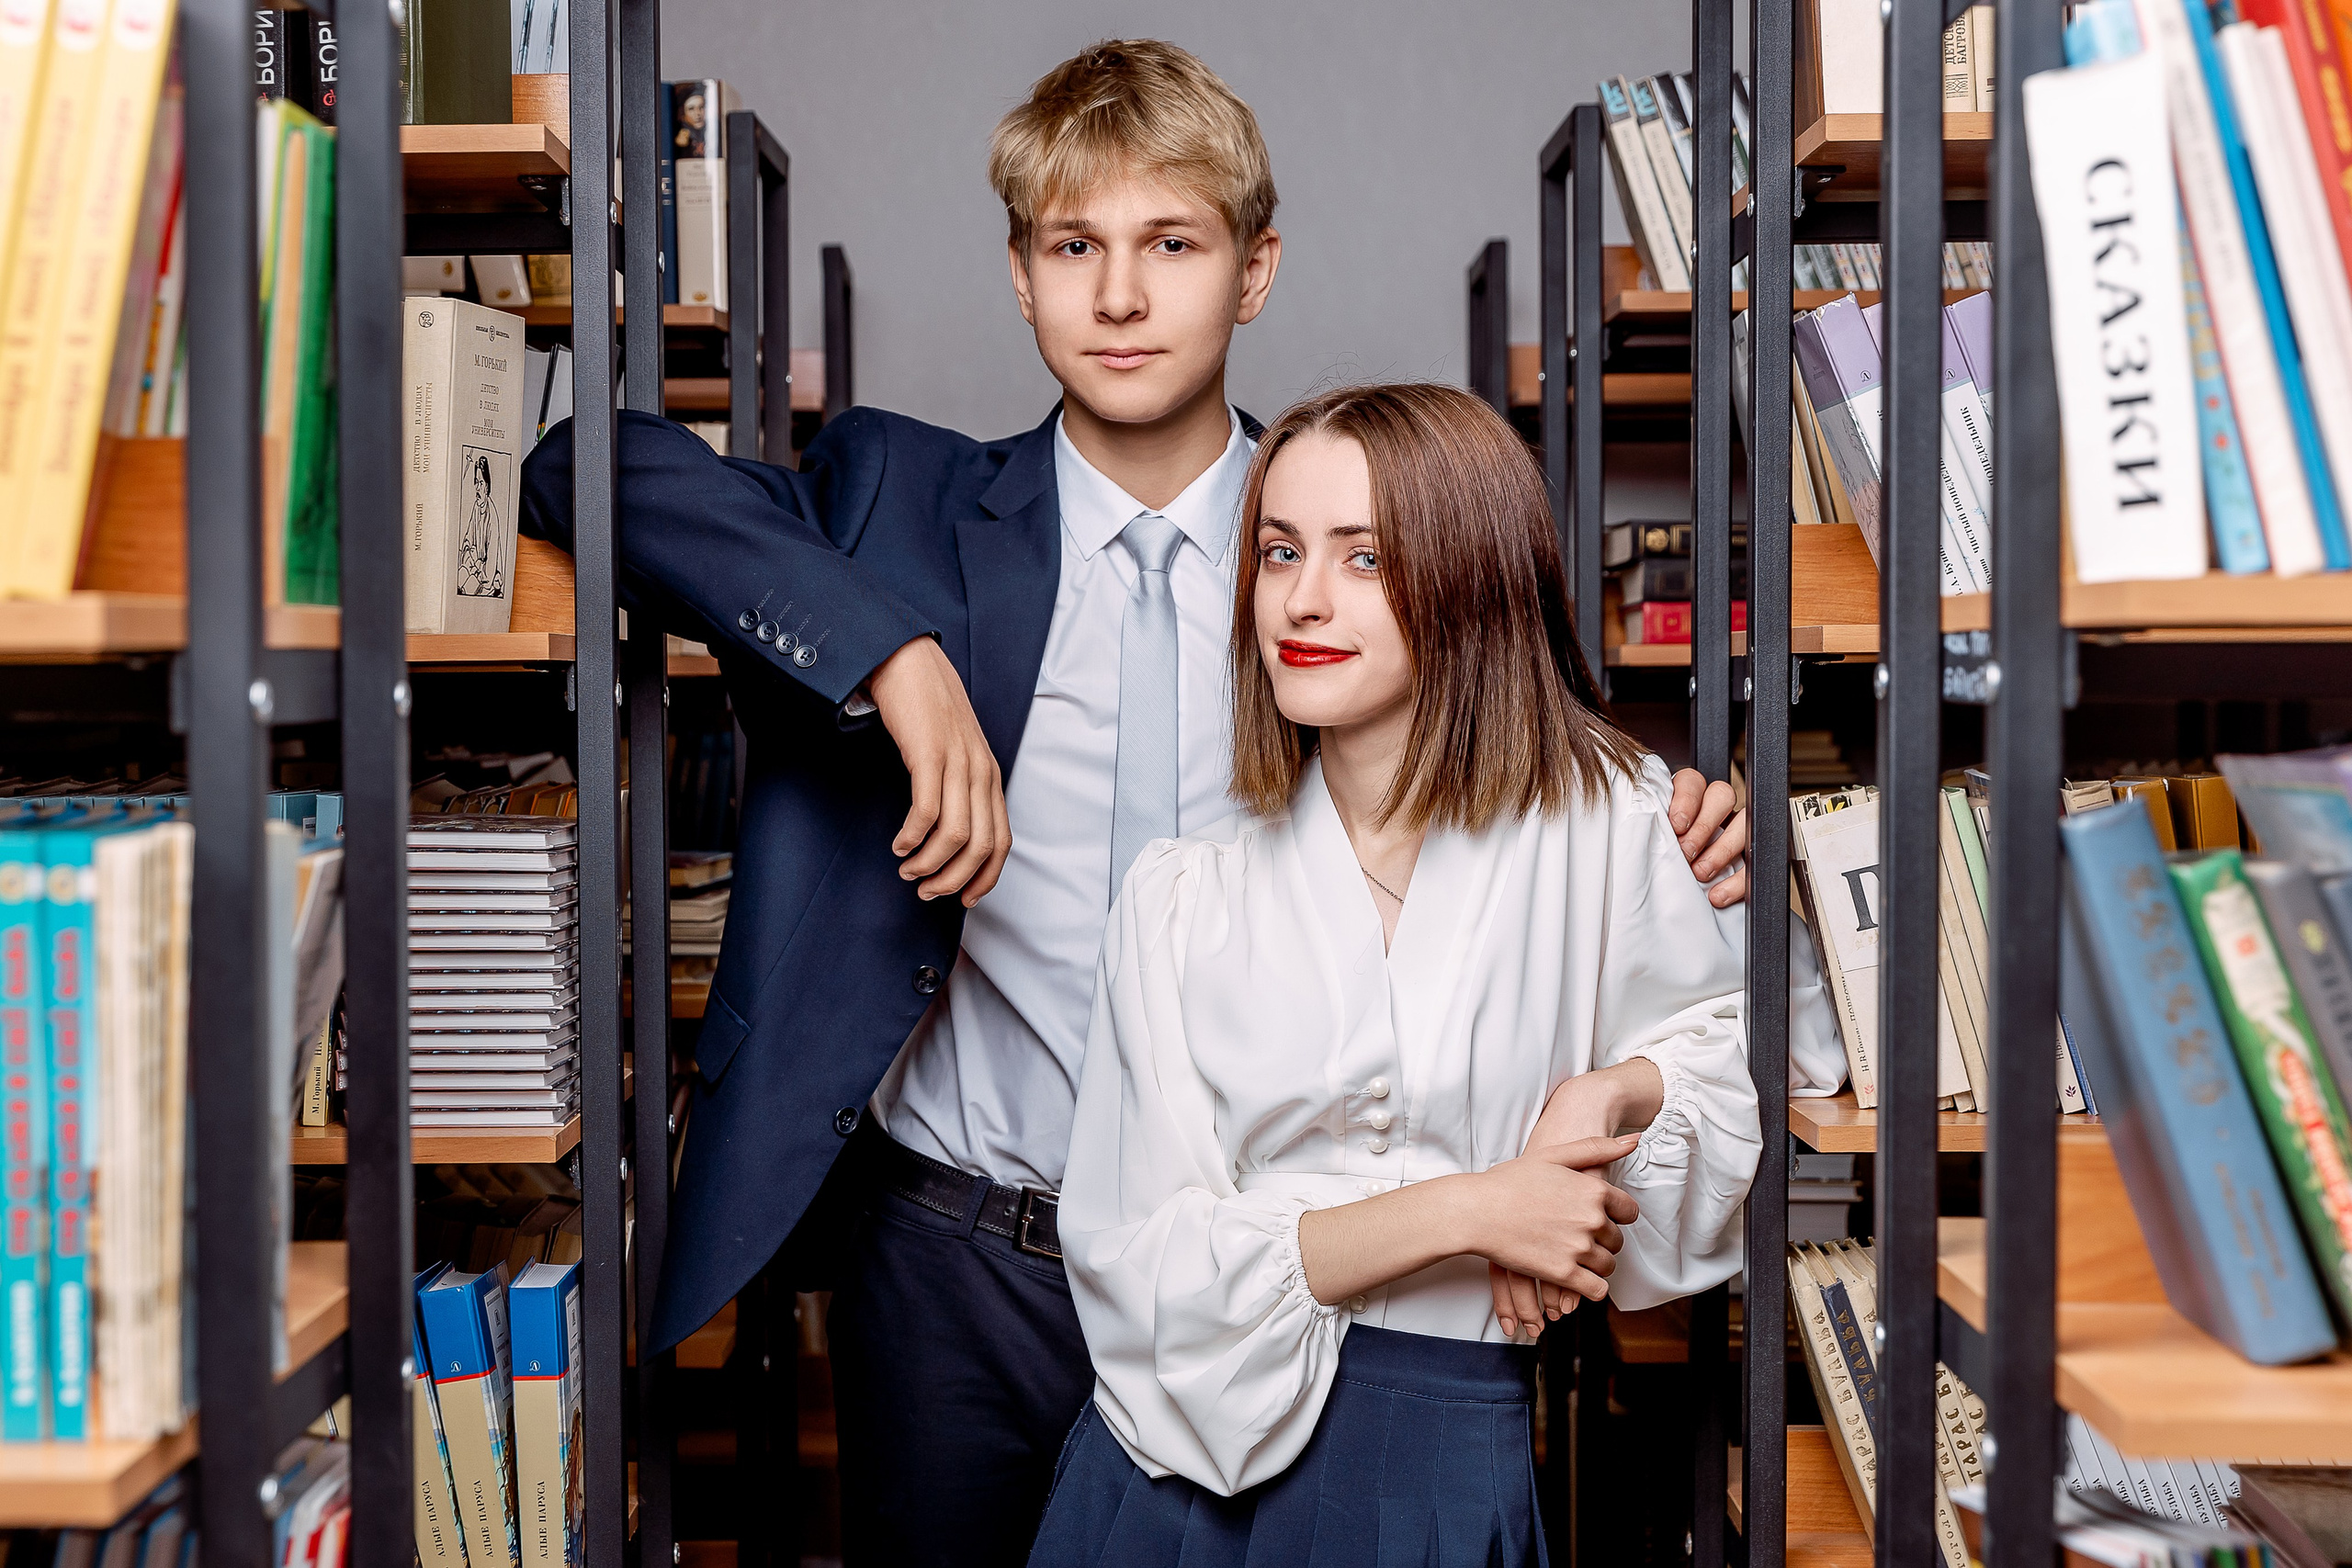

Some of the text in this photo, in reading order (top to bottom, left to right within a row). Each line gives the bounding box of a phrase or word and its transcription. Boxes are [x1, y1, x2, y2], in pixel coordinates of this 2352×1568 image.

[2086, 157, 2162, 512] СКАЗКИ
[1958, 513, 1980, 554] ЧИСТЫЙ
[312, 1066, 322, 1101] Горький
[1811, 1309, 1853, 1405] БУЛЬБА
[1945, 1407, 1984, 1483] ТАРАС
[421, 1480, 447, 1558] АЛЫЕ ПАРУСА
[473, 1480, 494, 1558] АЛЫЕ ПАРУСА
[537, 1481, 548, 1560] АЛЫЕ ПАРУСА
[2161, 1481, 2183, 1521] БУЛЬБА
[2188, 1483, 2211, 1525] БУЛЬБА
